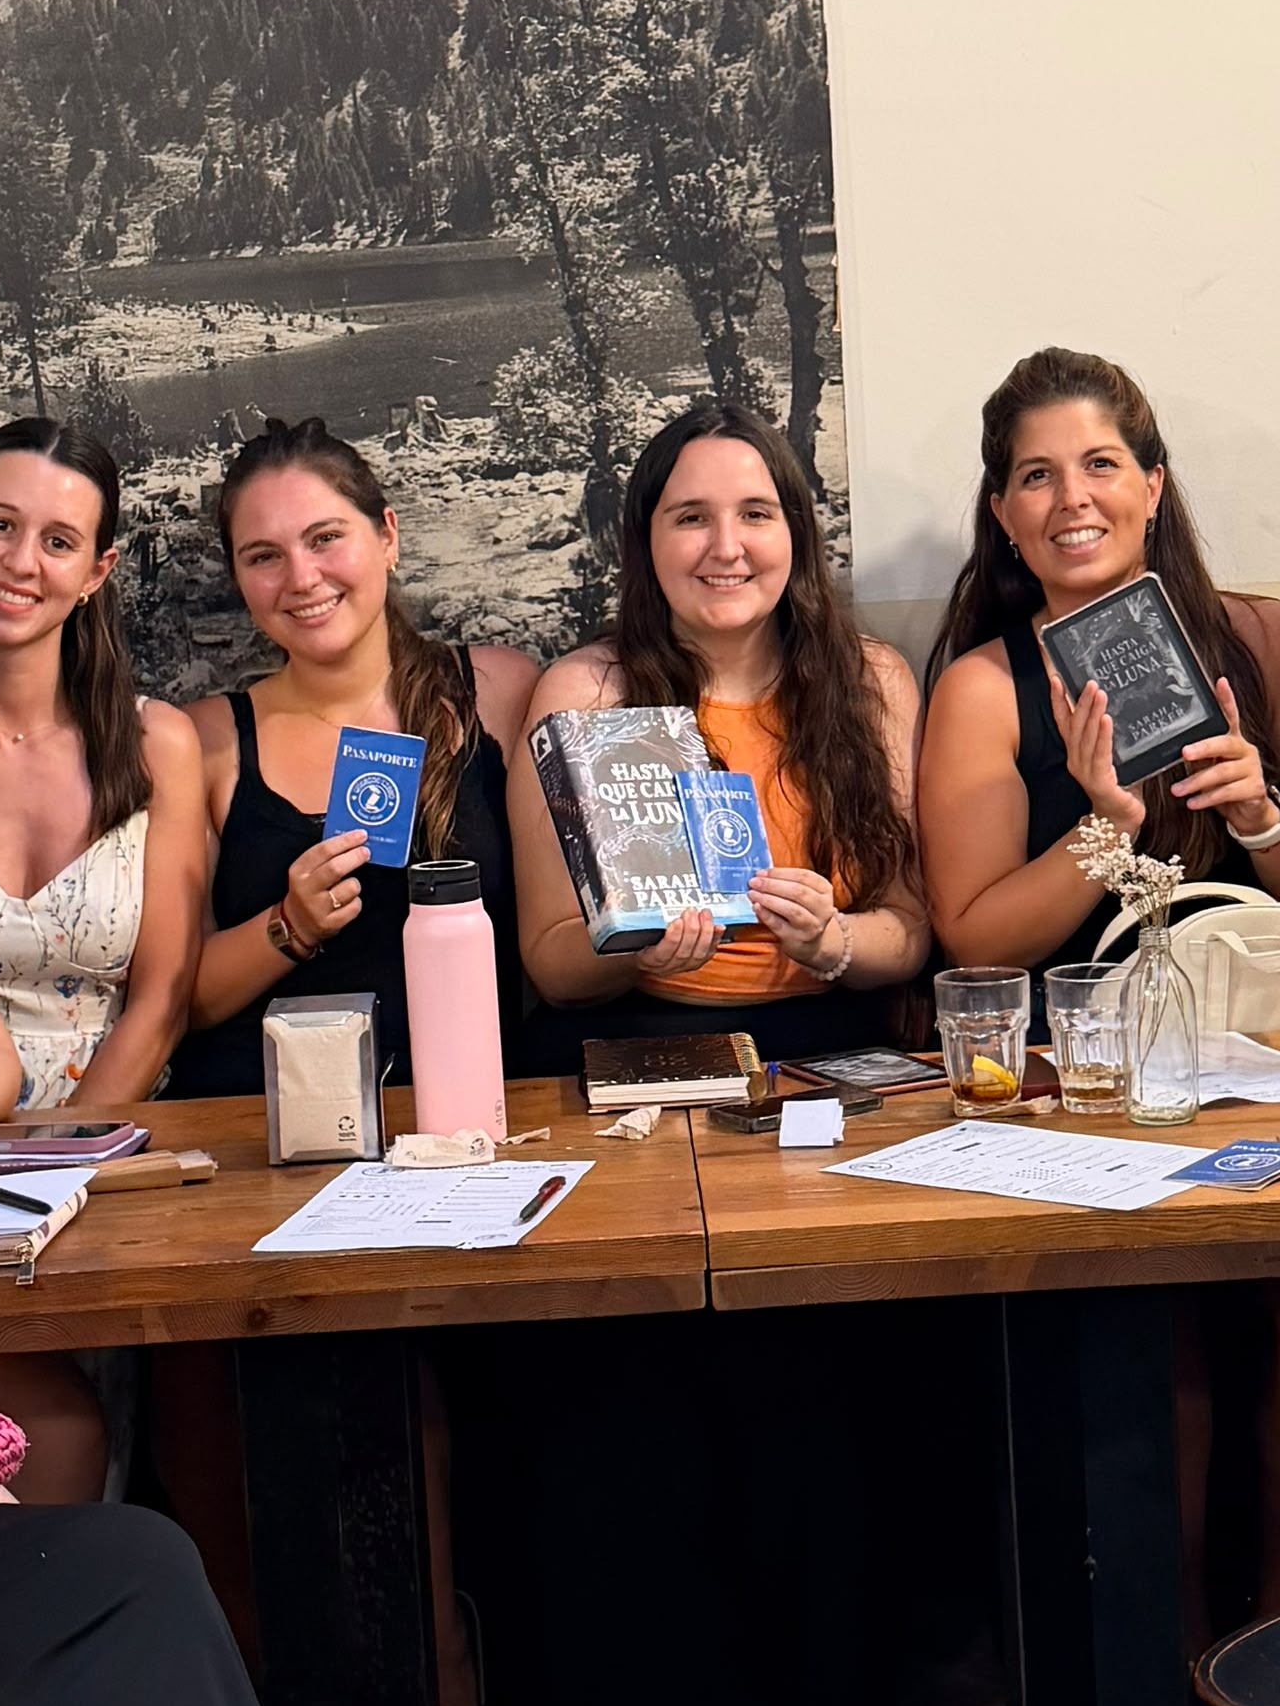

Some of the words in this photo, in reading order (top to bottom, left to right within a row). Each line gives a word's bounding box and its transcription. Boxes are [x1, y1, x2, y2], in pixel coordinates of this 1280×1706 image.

[1094, 662, 1118, 681] QUE
[1119, 641, 1158, 667] CAIGA
[1099, 637, 1139, 662] HASTA
[1103, 679, 1117, 692] LA
[1113, 656, 1163, 689] LUNA
[1131, 708, 1185, 741] PARKER
[342, 744, 418, 768] PASAPORTE
[610, 762, 673, 781] HASTA
[597, 782, 638, 805] QUE
[639, 781, 677, 798] CAI
[609, 806, 631, 821] LA
[626, 800, 685, 825] LUN
[630, 873, 699, 891] SARAH
